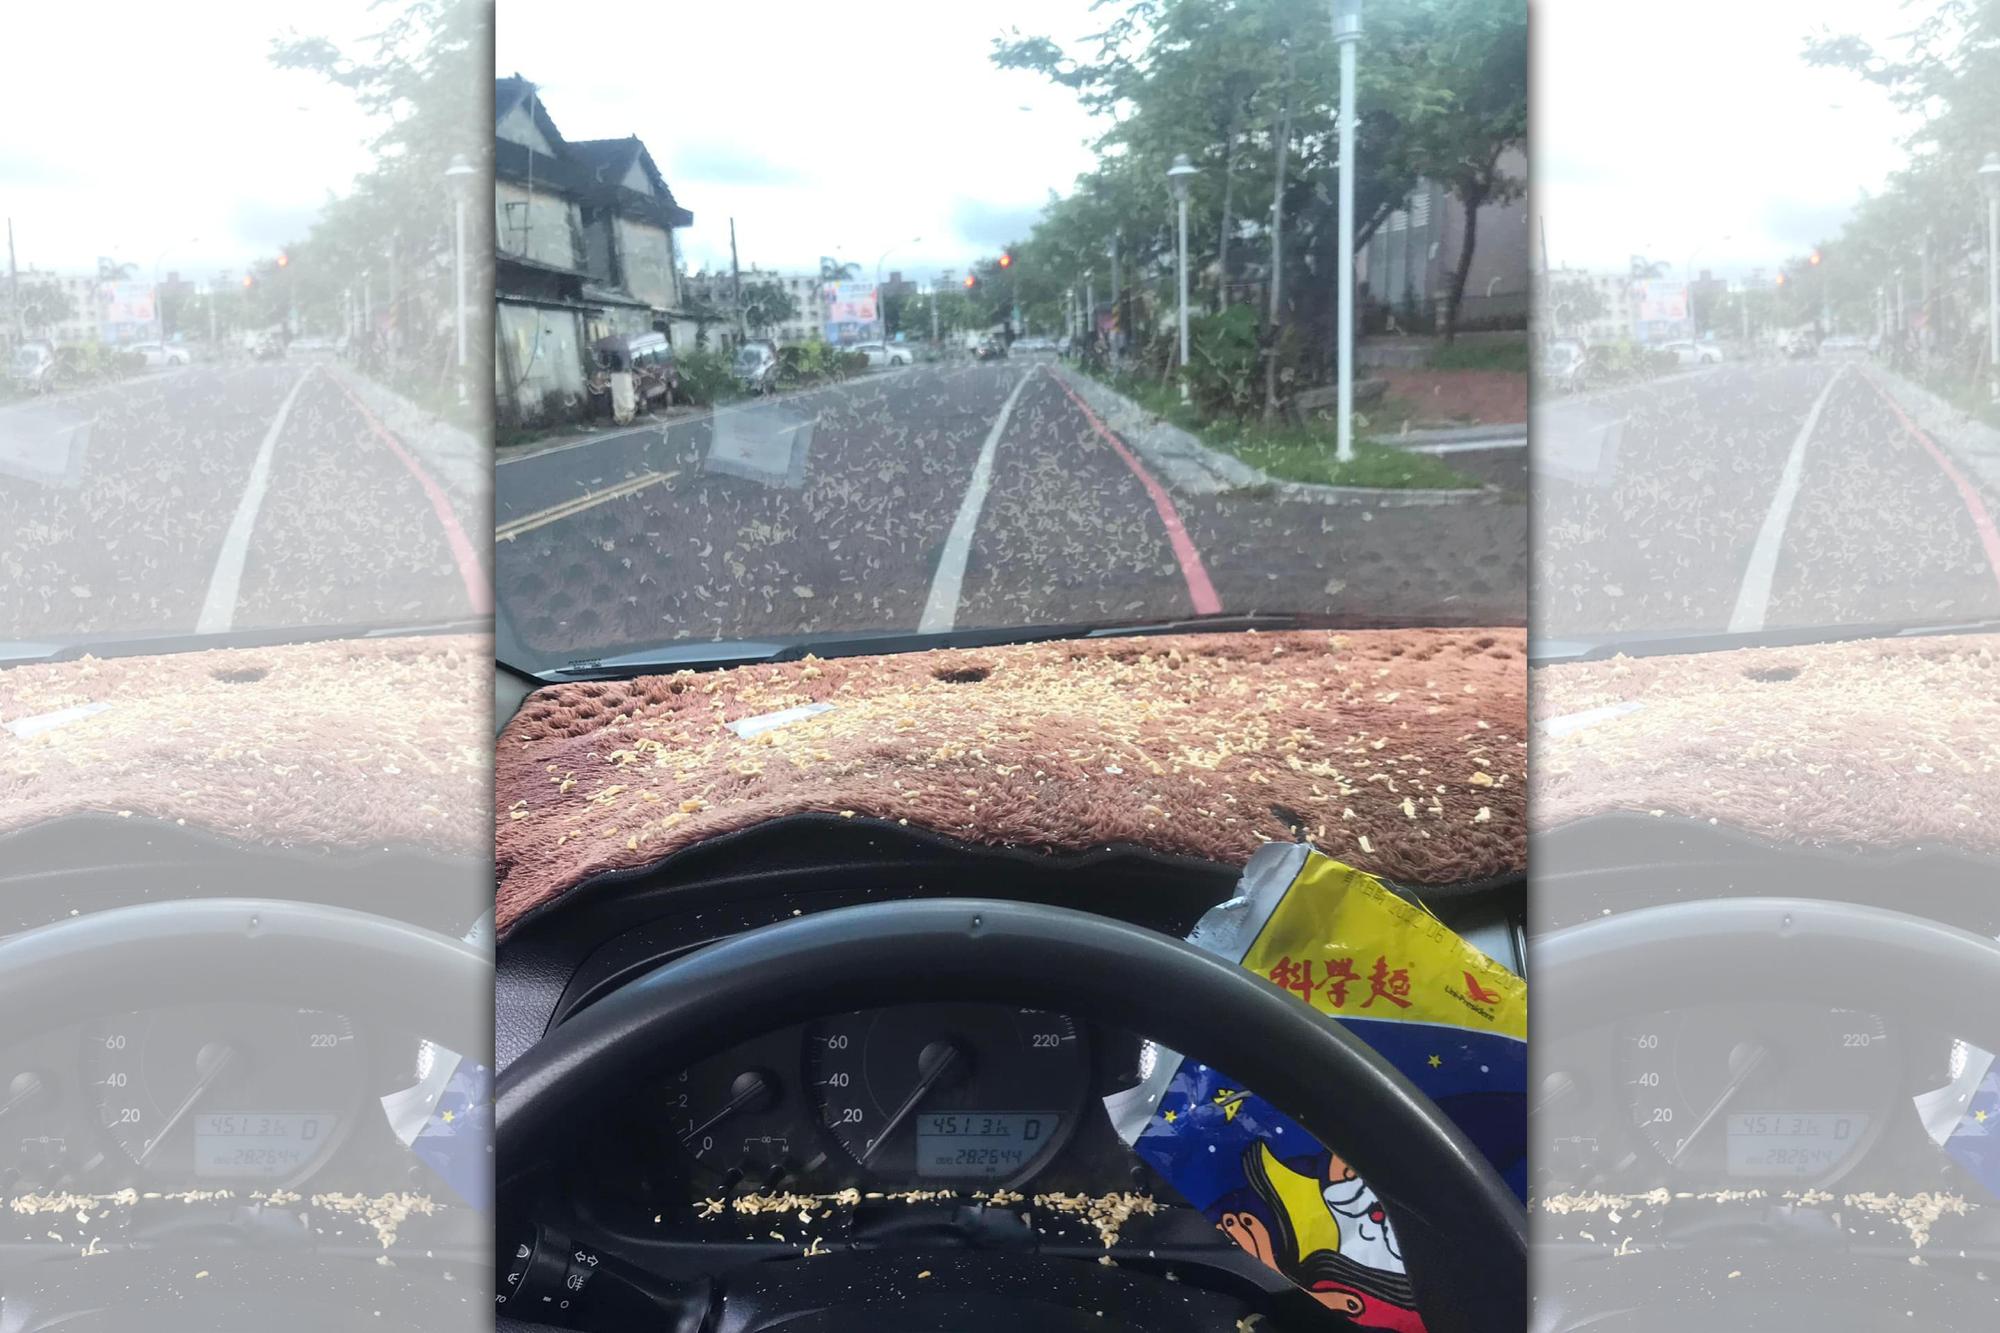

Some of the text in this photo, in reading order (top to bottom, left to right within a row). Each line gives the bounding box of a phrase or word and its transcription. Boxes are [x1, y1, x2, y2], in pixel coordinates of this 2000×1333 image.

[106, 1036, 126, 1049] 60
[311, 1034, 337, 1048] 220
[828, 1035, 848, 1049] 60
[1033, 1034, 1060, 1048] 220
[1638, 1035, 1659, 1049] 60
[1843, 1033, 1870, 1048] 220
[107, 1073, 127, 1087] 40
[829, 1073, 849, 1087] 40
[1639, 1073, 1659, 1087] 40
[679, 1094, 688, 1108] 2
[121, 1109, 141, 1122] 20
[843, 1108, 863, 1122] 20
[1653, 1108, 1673, 1122] 20
[703, 1136, 713, 1150] 0
